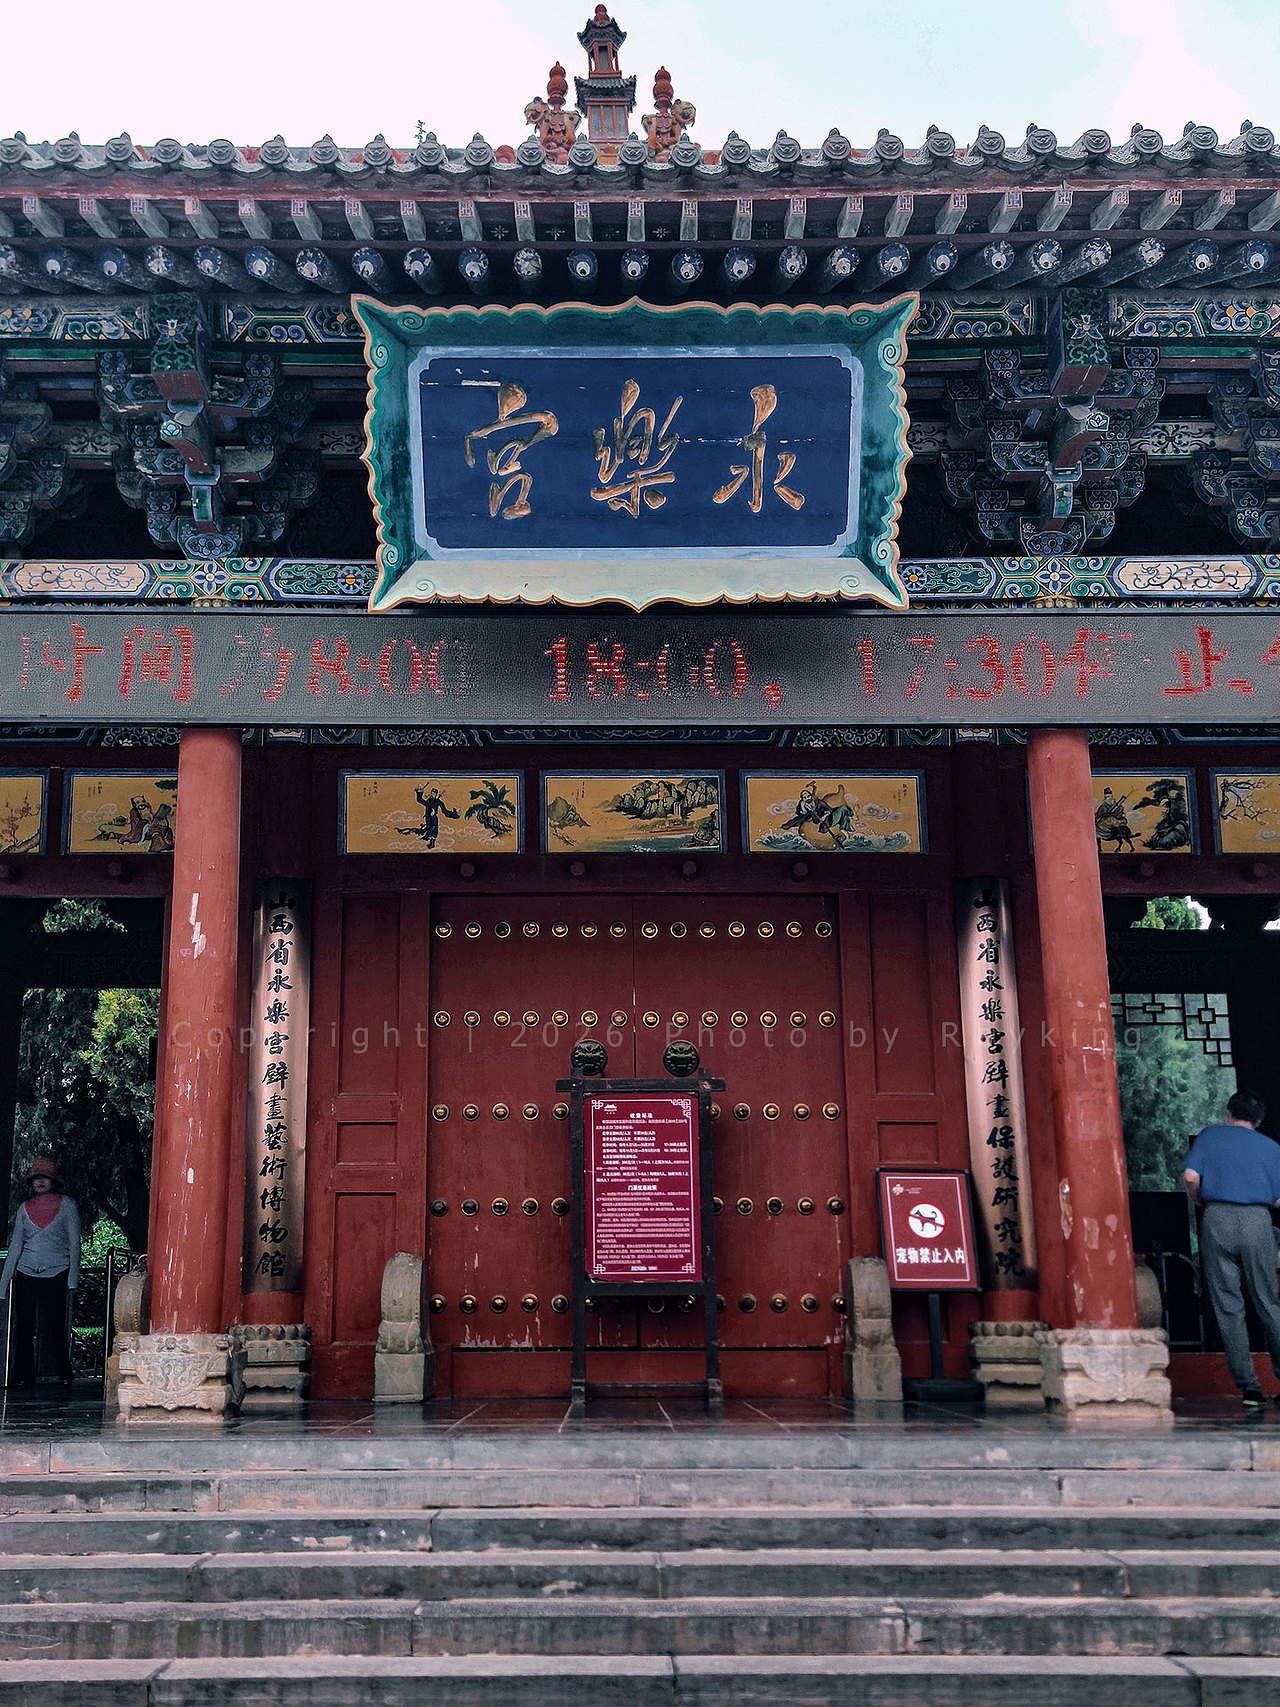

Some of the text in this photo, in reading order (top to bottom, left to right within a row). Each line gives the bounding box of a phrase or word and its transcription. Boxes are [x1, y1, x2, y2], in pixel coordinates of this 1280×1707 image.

[896, 1247, 966, 1265] 宠物禁止入内
